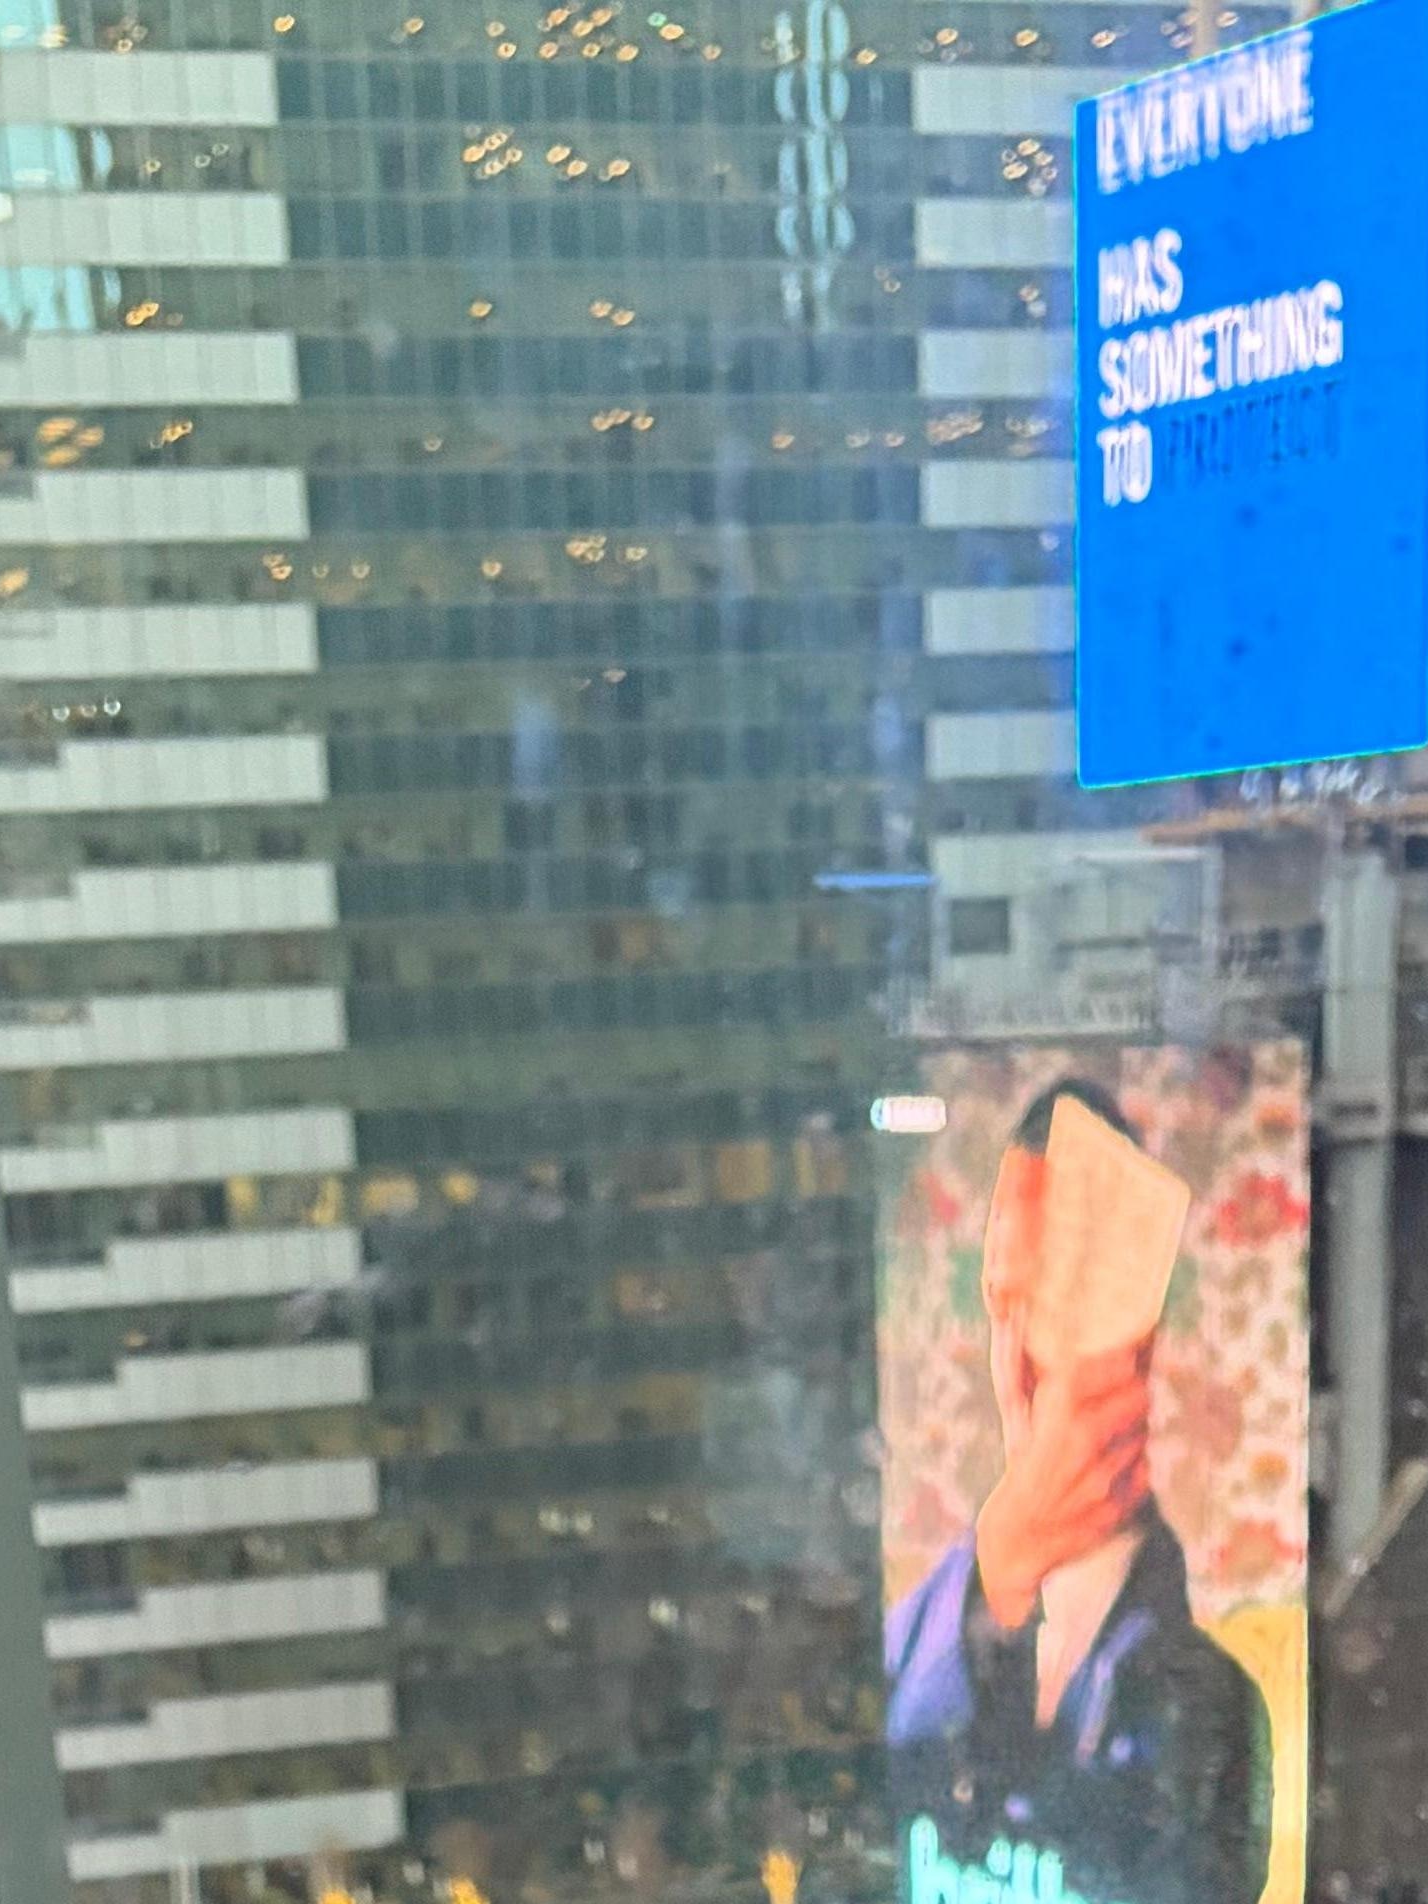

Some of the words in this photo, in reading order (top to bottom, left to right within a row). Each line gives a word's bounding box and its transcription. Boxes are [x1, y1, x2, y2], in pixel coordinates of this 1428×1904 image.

[1097, 31, 1315, 194] EVERYONE
[1098, 227, 1182, 329] HAS
[1098, 280, 1344, 420] SOMETHING
[1097, 423, 1153, 507] TO
